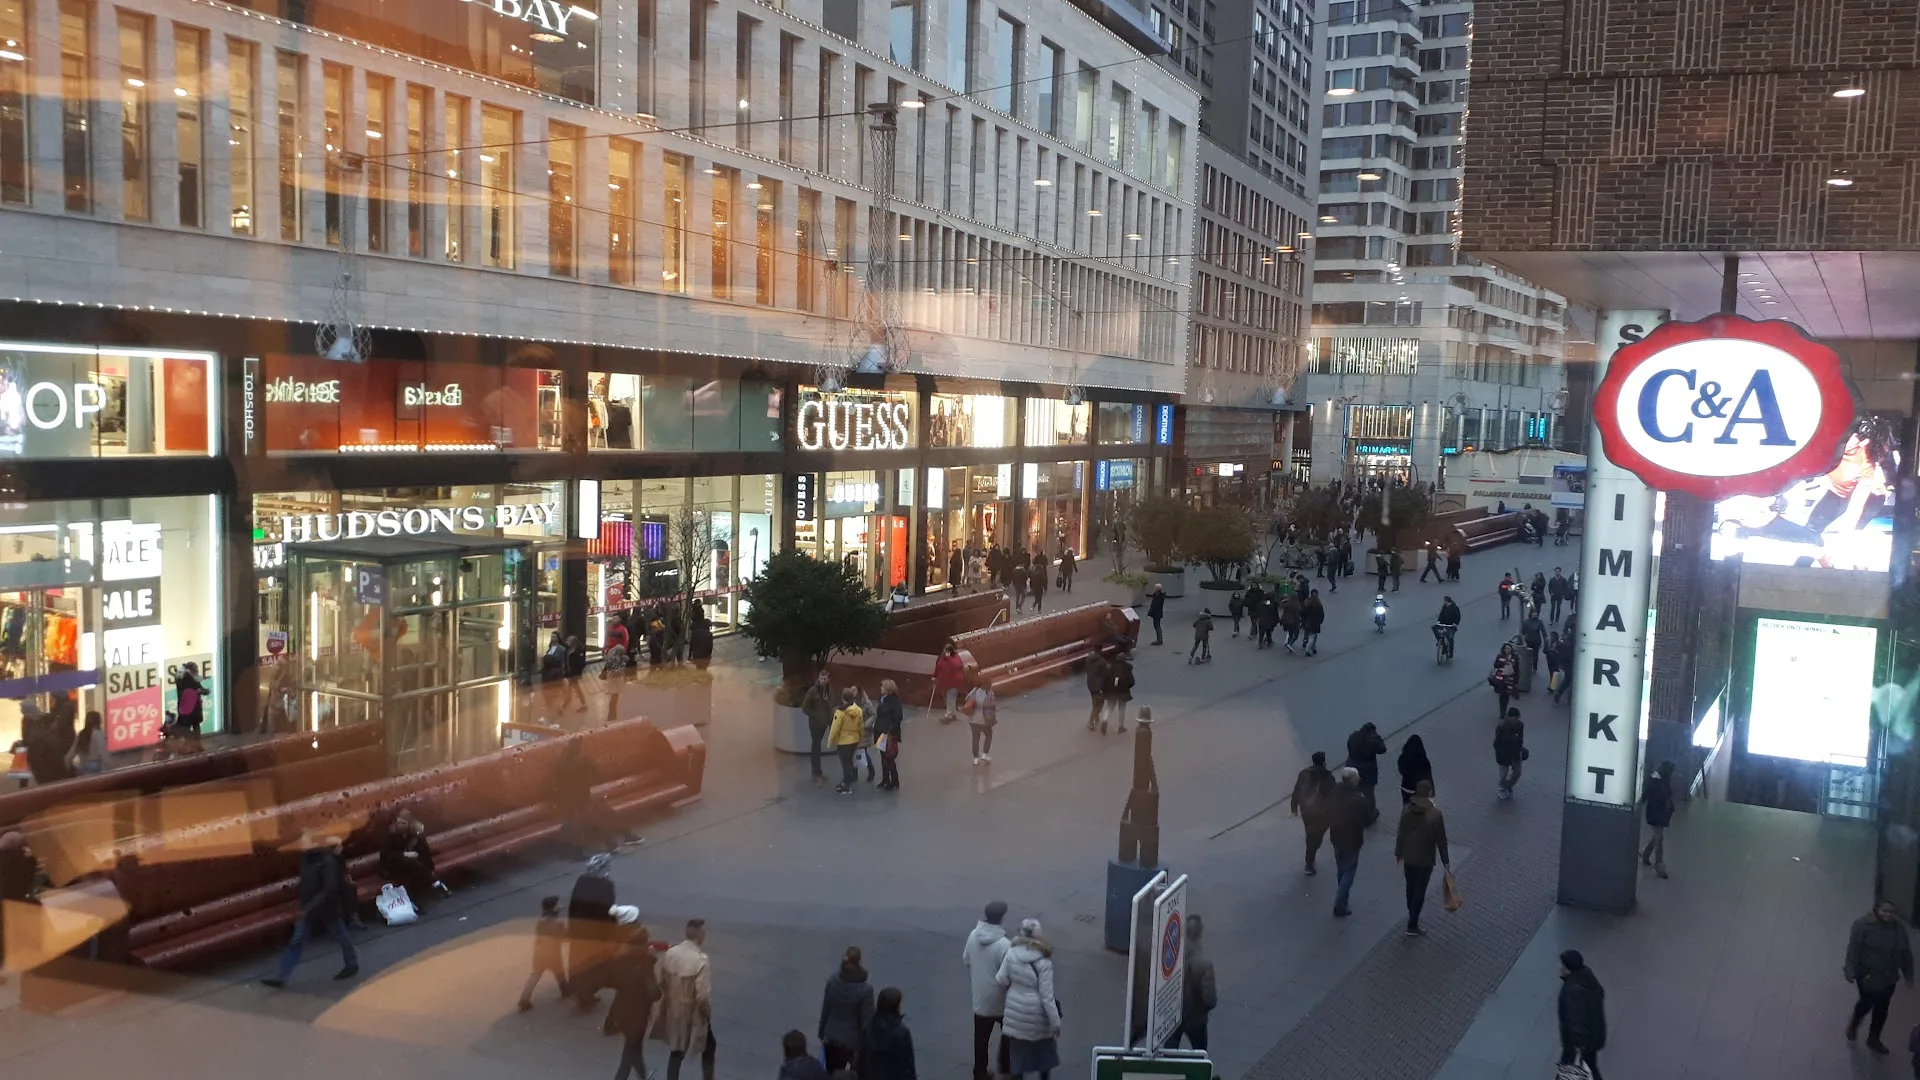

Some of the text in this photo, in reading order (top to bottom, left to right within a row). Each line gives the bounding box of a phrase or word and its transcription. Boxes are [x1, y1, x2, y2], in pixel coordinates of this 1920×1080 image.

[245, 371, 254, 439] TOPSHOP
[1637, 368, 1797, 446] C&A
[797, 400, 909, 450] GUESS
[281, 500, 560, 544] HUDSON'S BAY
[880, 519, 905, 528] SLE
[360, 571, 370, 593] P
[109, 668, 157, 694] SALE
[167, 660, 212, 685] SE
[109, 703, 158, 724] 70%
[113, 720, 154, 741] OFF
